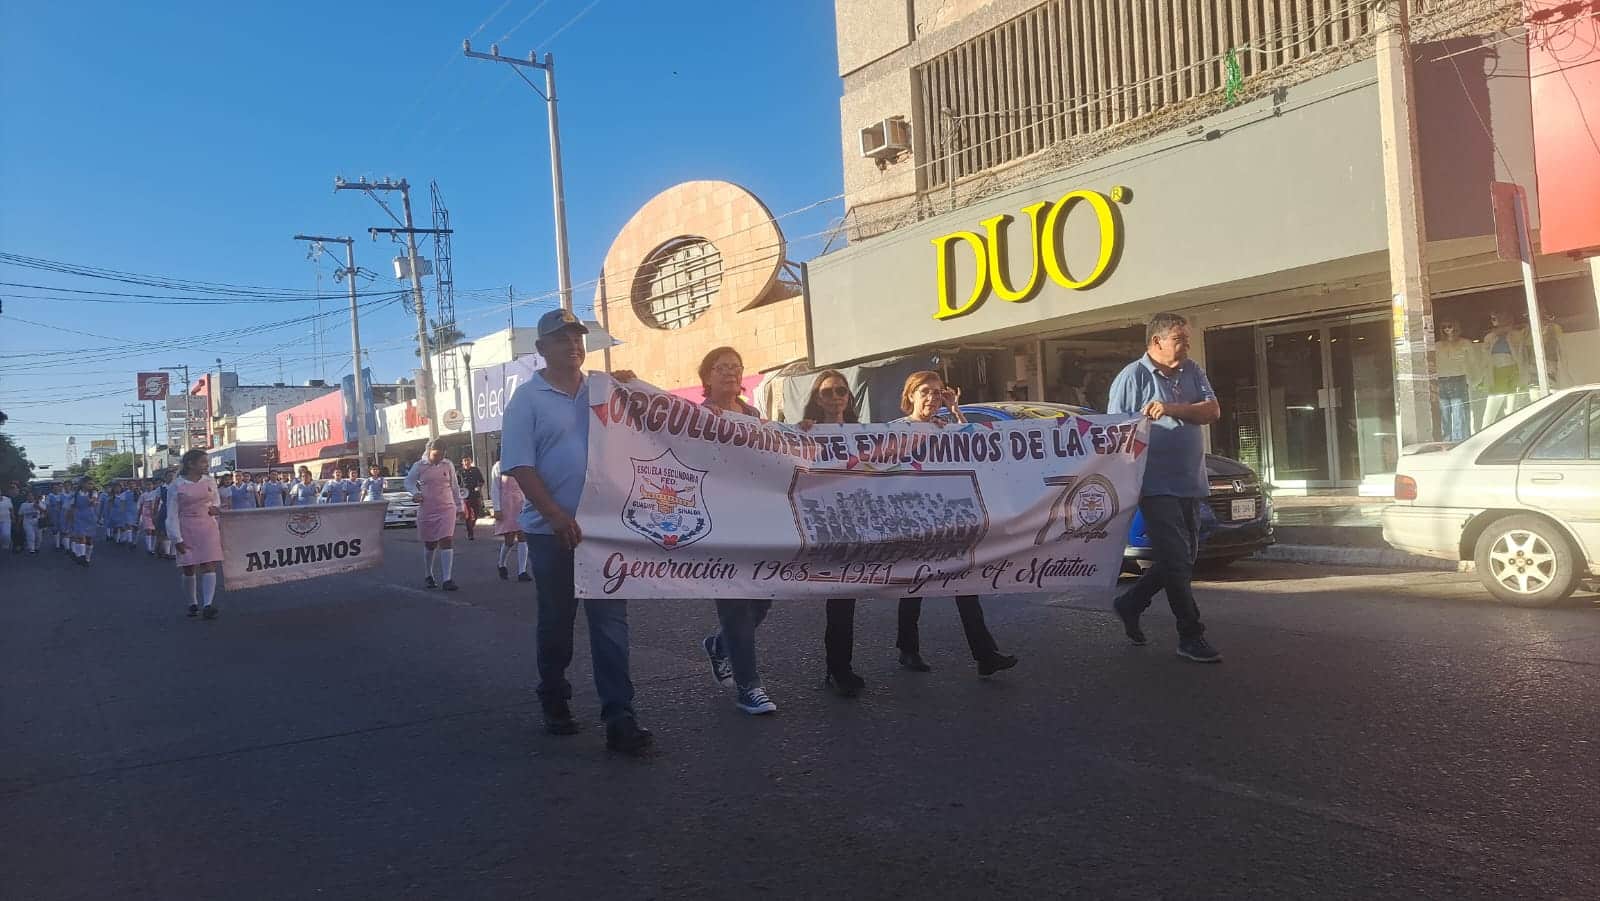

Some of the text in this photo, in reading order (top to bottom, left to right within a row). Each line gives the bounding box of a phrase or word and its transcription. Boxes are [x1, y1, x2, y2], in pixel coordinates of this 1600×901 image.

[930, 190, 1115, 320] DUO
[608, 388, 849, 462] ORGULLOSAMENTE
[855, 432, 1001, 463] EXALUMNOS
[1009, 430, 1043, 461] DE
[1053, 428, 1085, 458] LA
[637, 465, 699, 485] ESCUELA SECUNDARIA
[245, 538, 362, 572] ALUMNOS
[602, 551, 738, 595] Generación
[751, 560, 809, 582] 1968
[839, 561, 894, 585] 1971
[1015, 556, 1098, 589] Matutino
